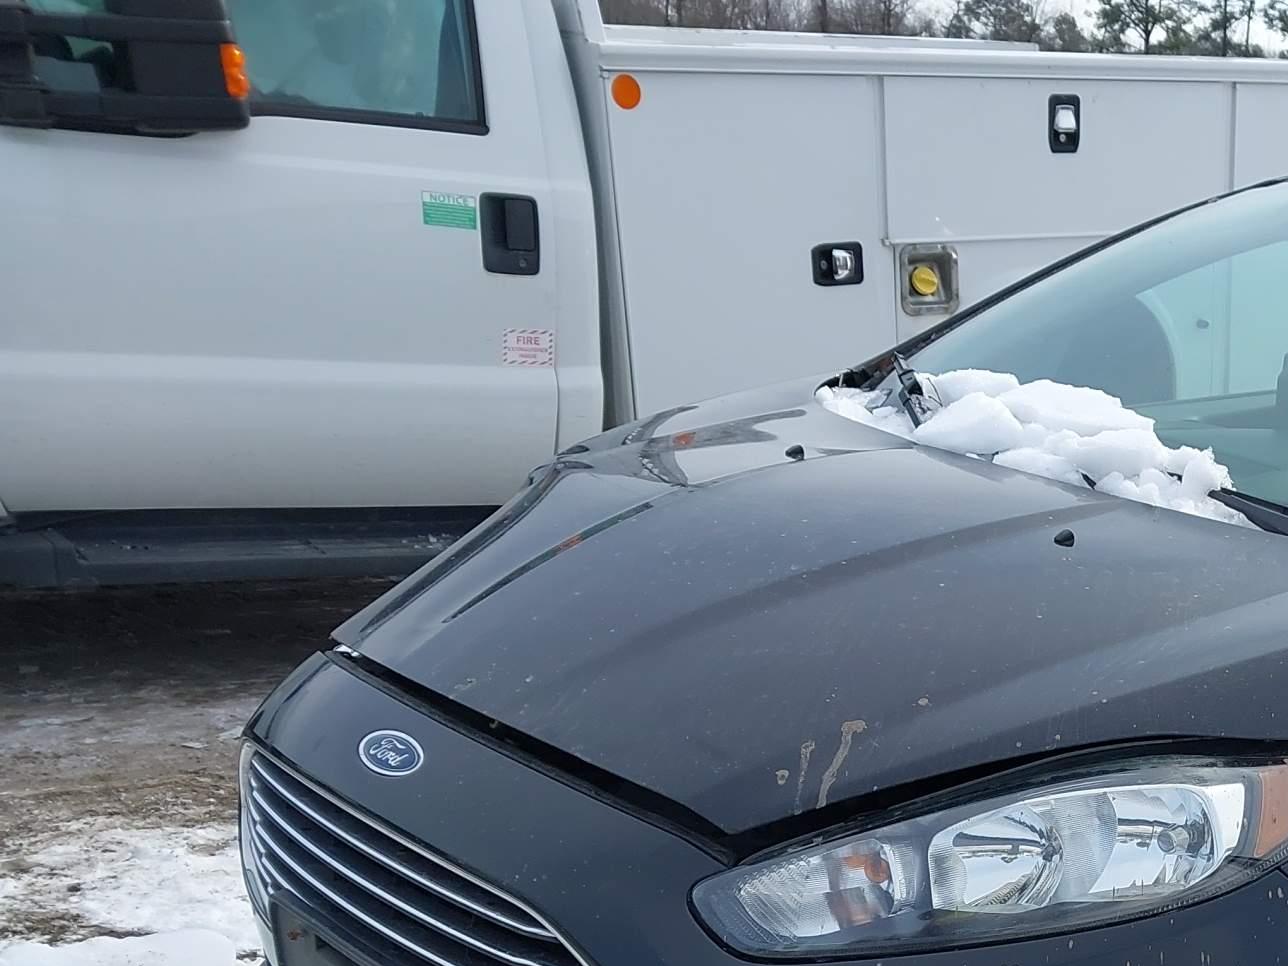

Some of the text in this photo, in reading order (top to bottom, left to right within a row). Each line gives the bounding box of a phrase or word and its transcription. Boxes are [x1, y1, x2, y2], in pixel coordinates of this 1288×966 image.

[429, 191, 470, 207] NOTICE
[516, 335, 541, 346] FIRE
[369, 738, 409, 766] Ford
